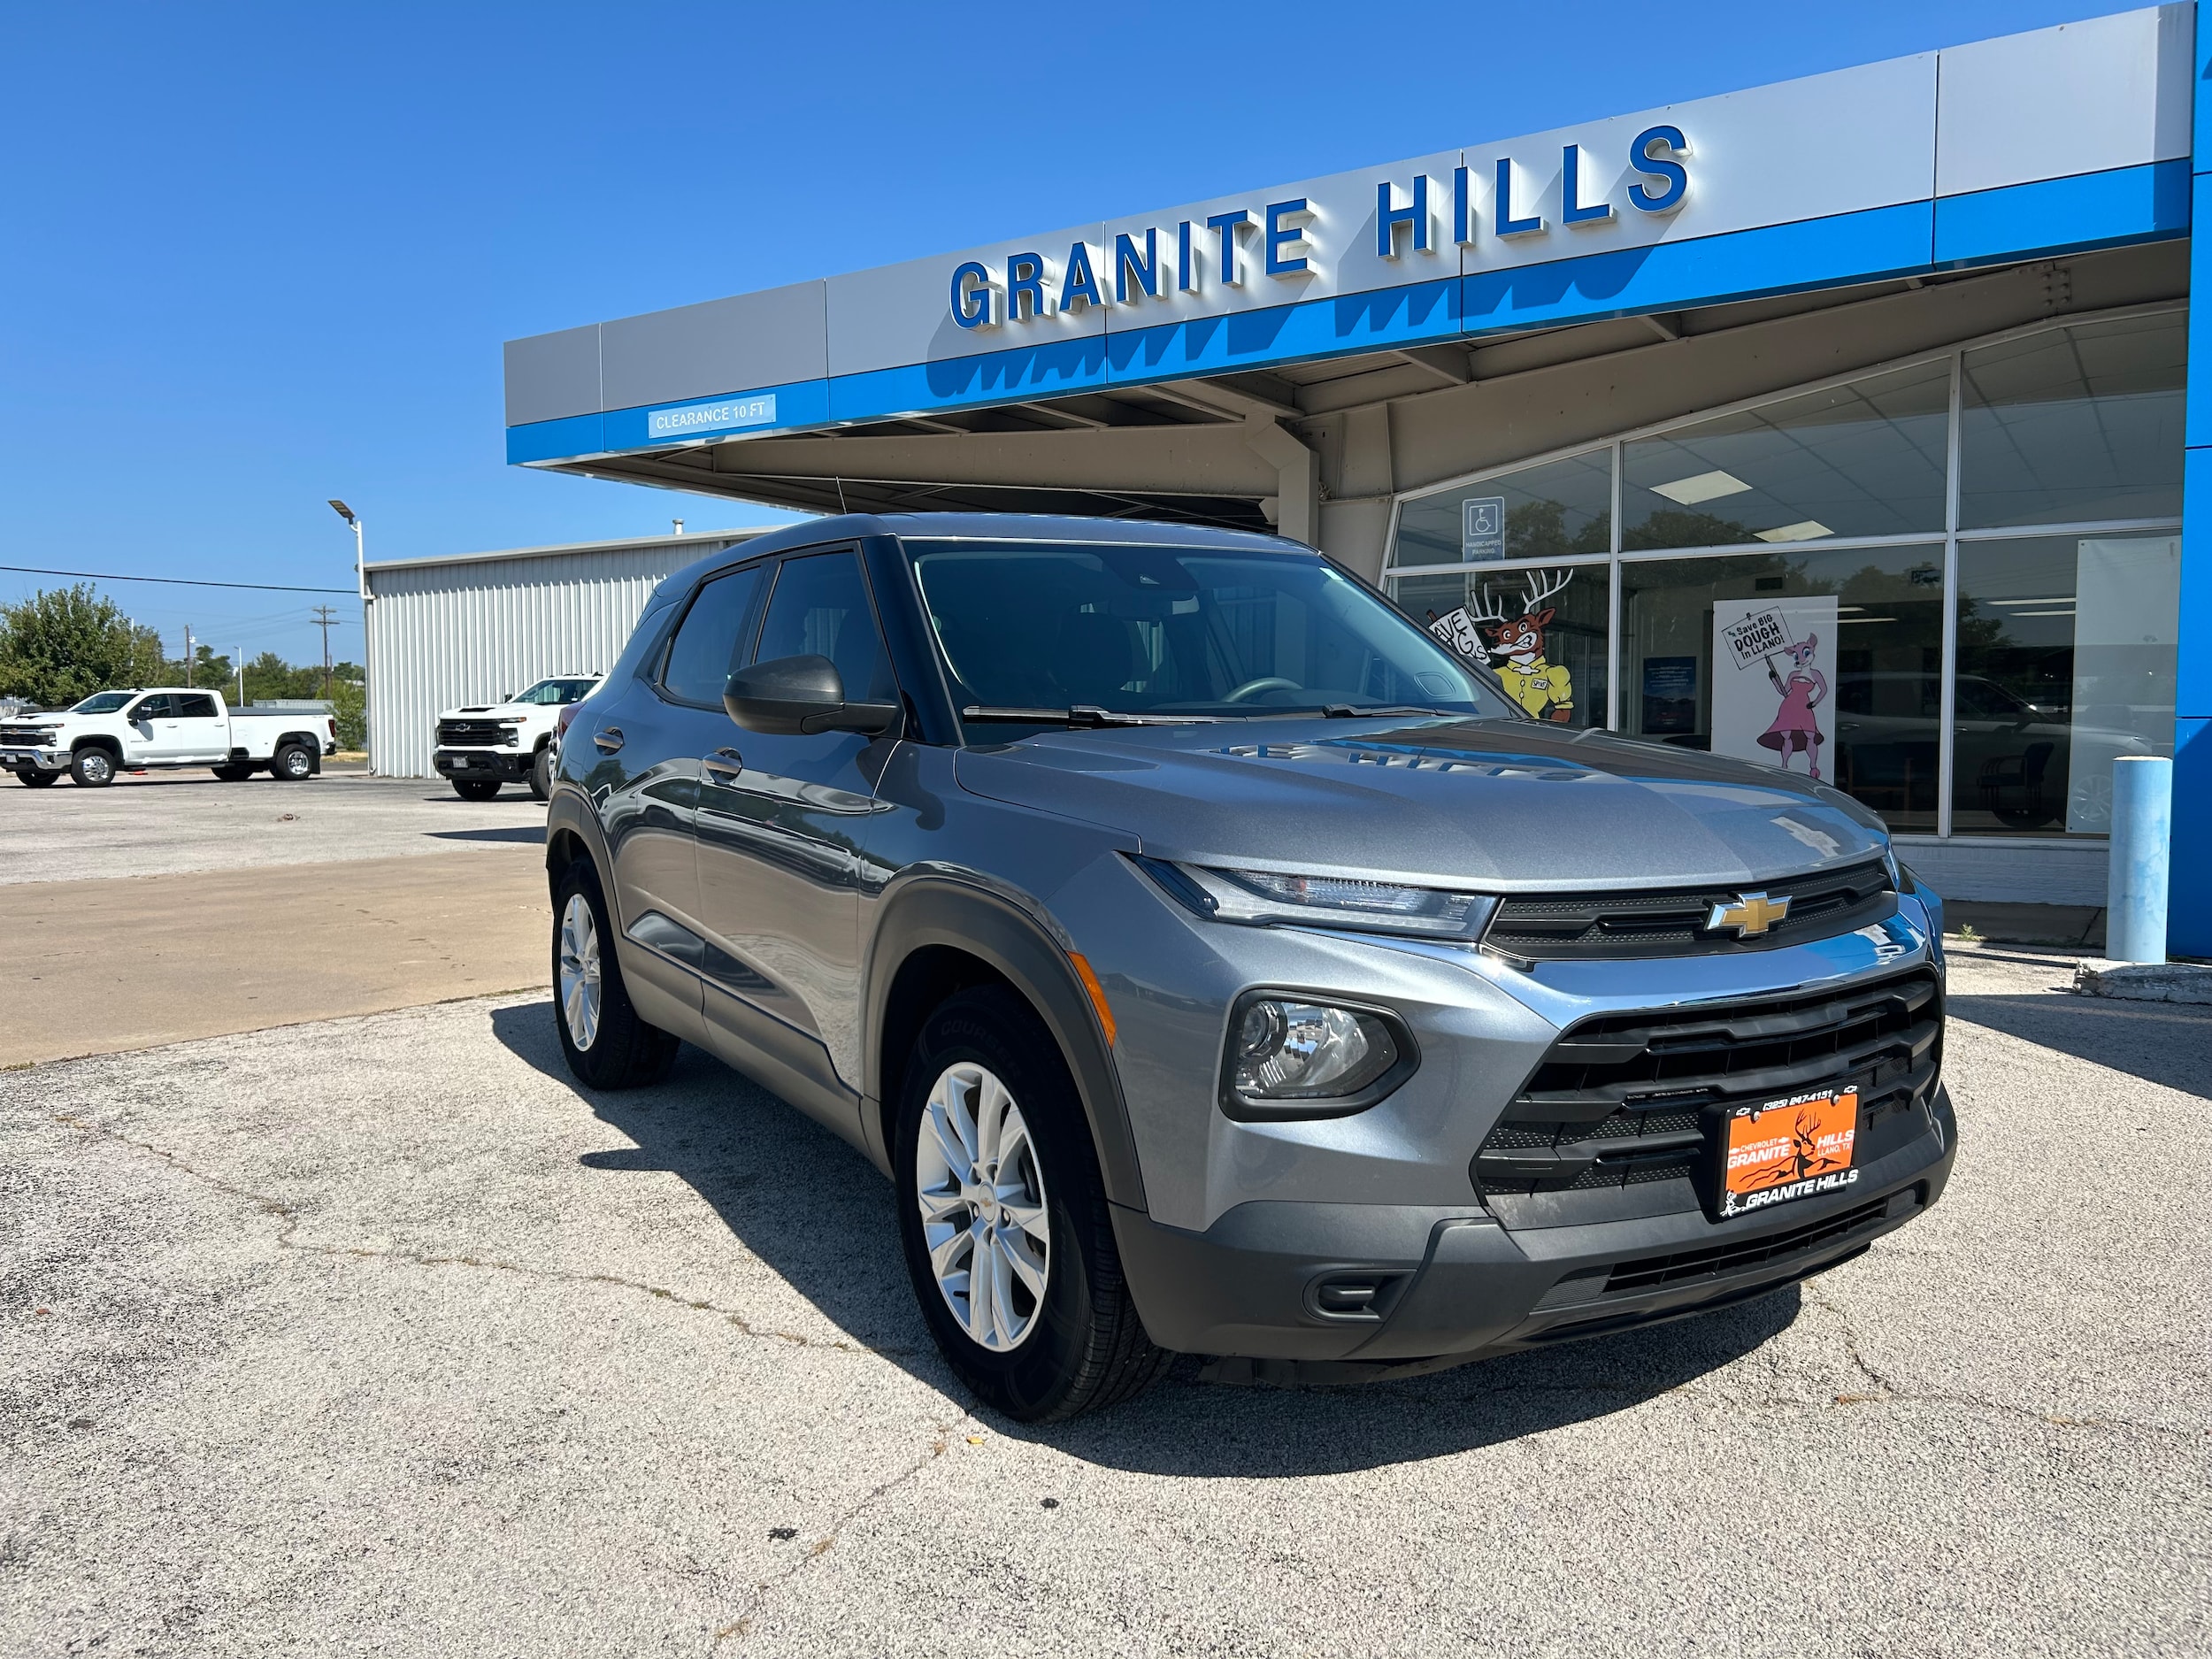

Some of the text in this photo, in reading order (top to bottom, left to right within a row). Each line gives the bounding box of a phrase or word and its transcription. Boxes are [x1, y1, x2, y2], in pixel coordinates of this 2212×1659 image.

[950, 124, 1691, 331] GRANITE HILLS
[656, 402, 765, 430] CLEARANCE 10 FT
[1734, 622, 1781, 652] DOUGH
[1736, 614, 1773, 635] Save BIG
[1751, 634, 1785, 656] LLANO!
[1762, 1089, 1833, 1111] (325) 247-4151
[1727, 1130, 1855, 1169] GRANITE HILLS
[1740, 1138, 1778, 1153] CHEVROLET
[1745, 1169, 1859, 1209] GRANITE HILLS
